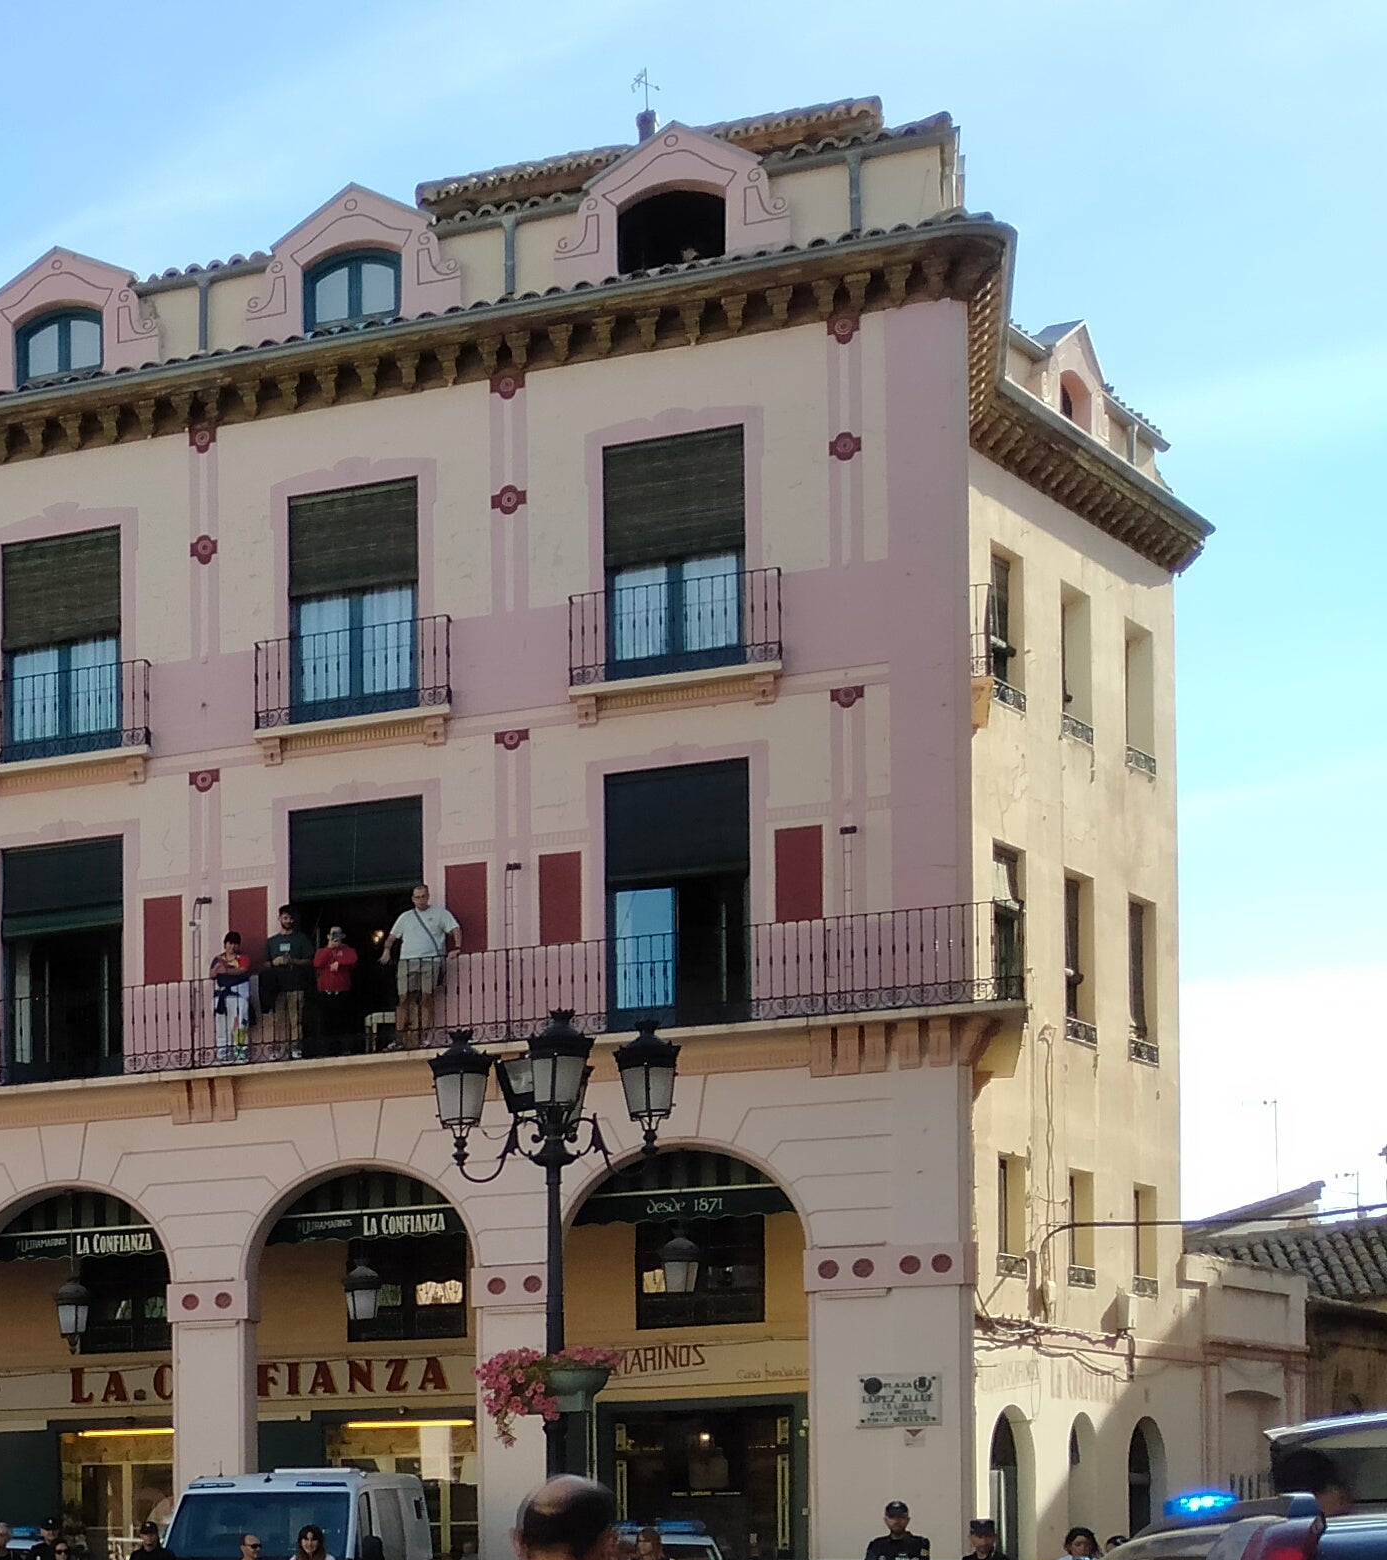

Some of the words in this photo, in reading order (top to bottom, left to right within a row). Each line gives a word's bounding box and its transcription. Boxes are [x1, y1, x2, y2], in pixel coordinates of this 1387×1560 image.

[647, 1197, 686, 1214] desde
[694, 1197, 723, 1213] 1871
[363, 1215, 377, 1236] LA
[381, 1213, 446, 1235] CONFIANZA
[76, 1235, 90, 1254] LA
[93, 1233, 153, 1253] CONFIANZA
